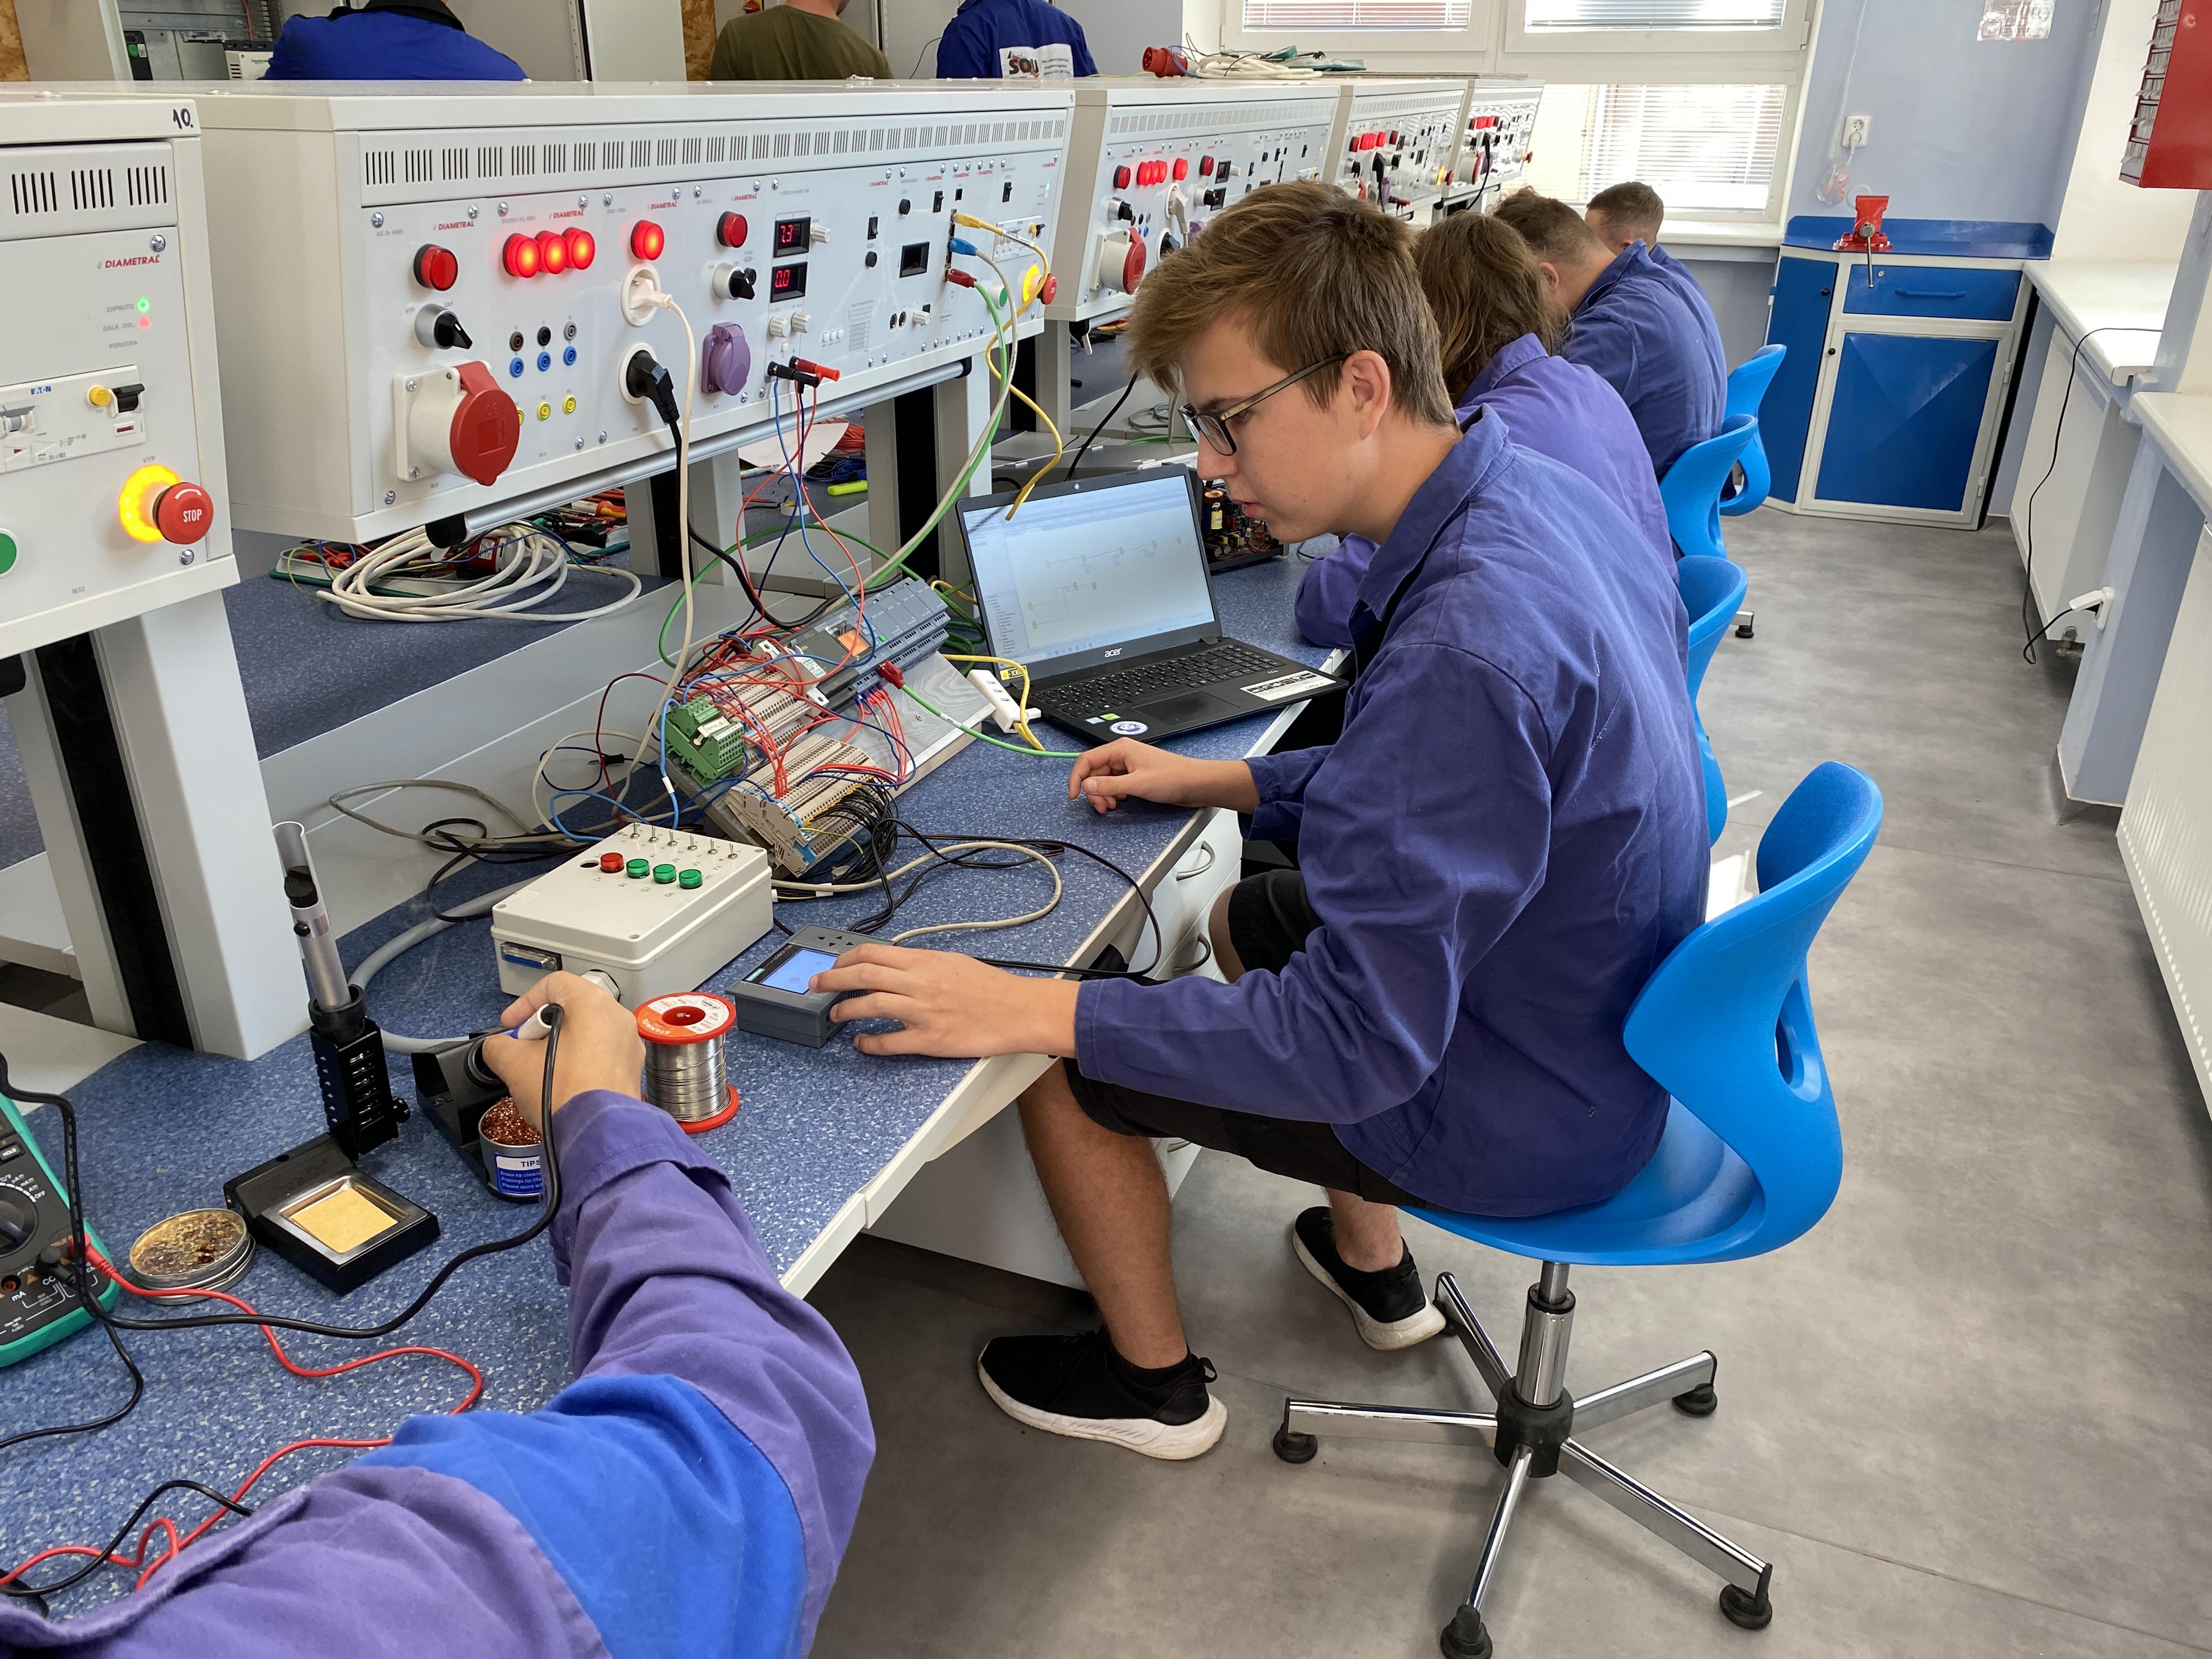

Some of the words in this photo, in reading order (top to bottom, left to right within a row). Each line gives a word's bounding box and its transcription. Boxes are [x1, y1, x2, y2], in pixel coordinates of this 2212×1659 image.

[651, 201, 677, 210] DIAMETRAL
[553, 210, 584, 218] DIAMETRAL
[439, 221, 474, 230] DIAMETRAL
[105, 255, 160, 268] DIAMETRAL
[182, 509, 202, 523] STOP
[1105, 648, 1122, 658] acer
[641, 1019, 671, 1035] STANNOL
[3, 1148, 17, 1156] HOLD
[521, 1159, 540, 1167] TIPS
[35, 1190, 45, 1199] OFF
[12, 1291, 27, 1301] mA
